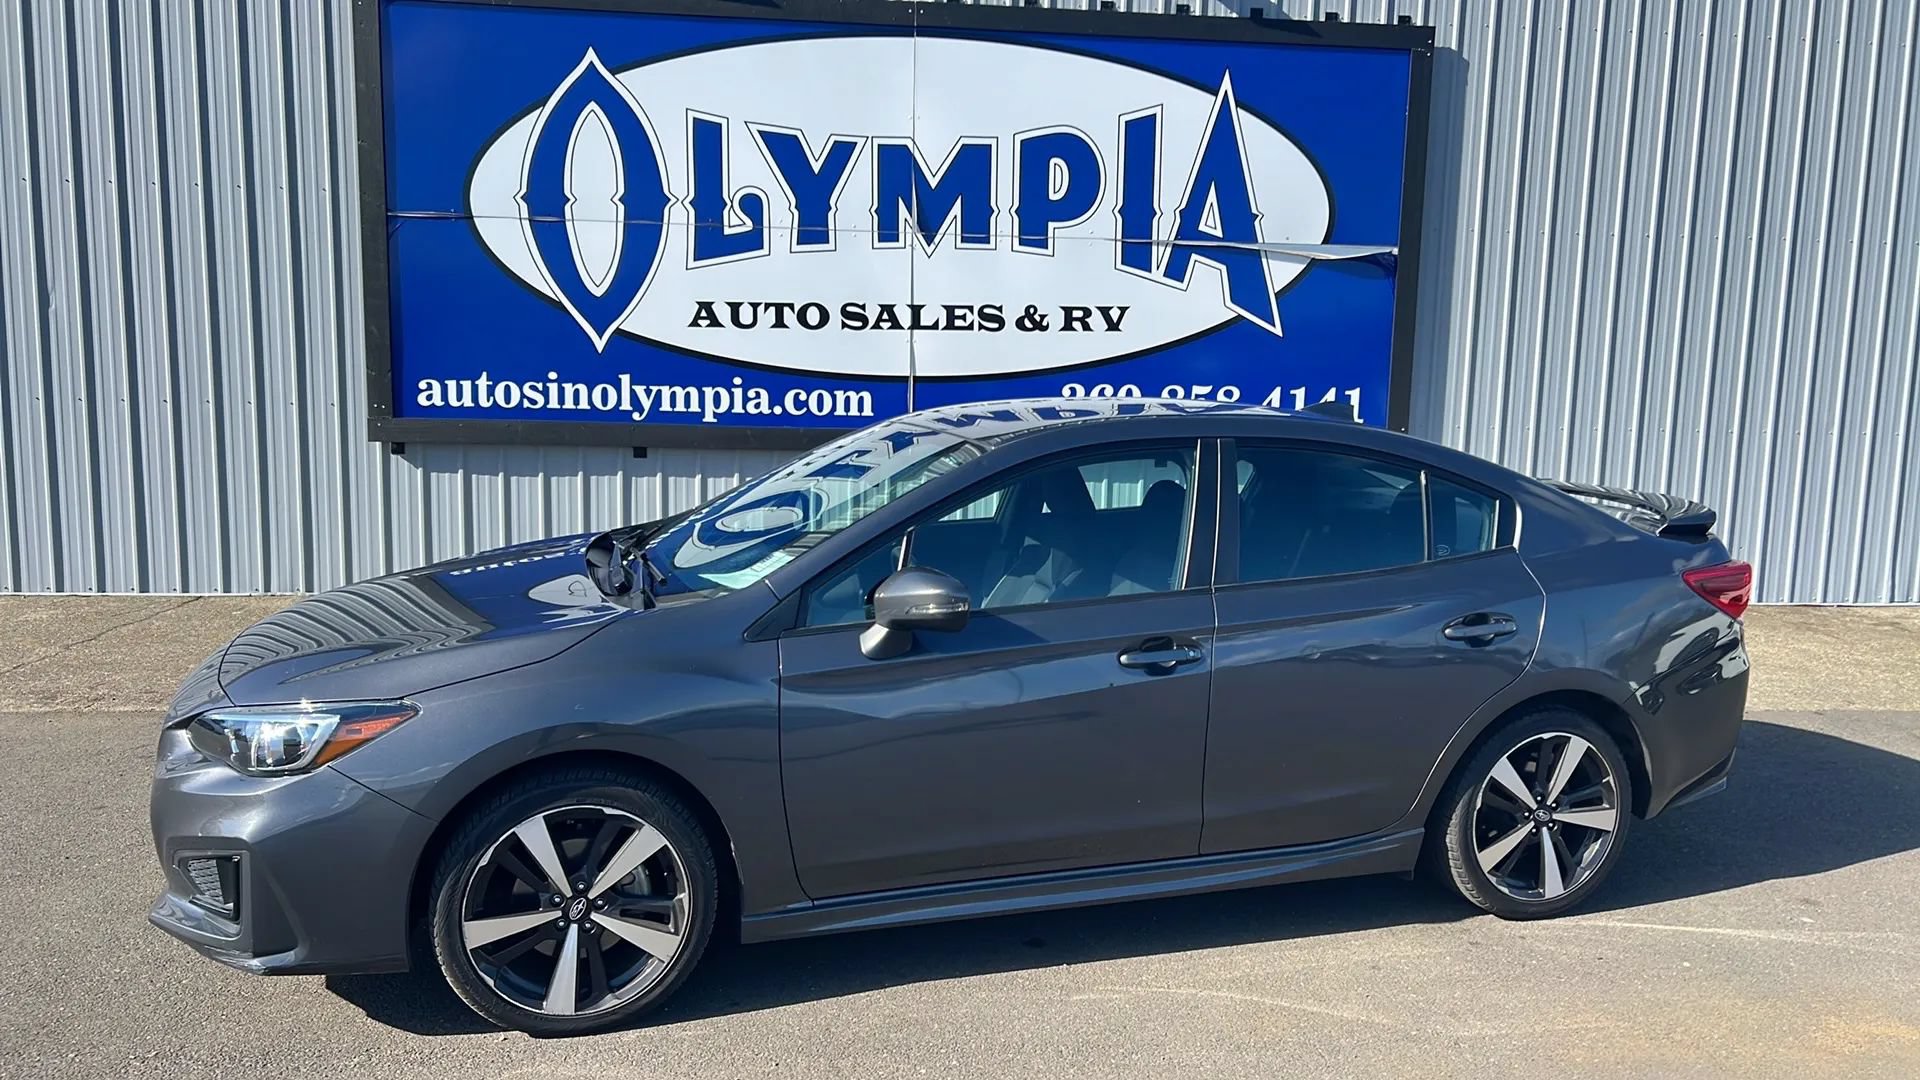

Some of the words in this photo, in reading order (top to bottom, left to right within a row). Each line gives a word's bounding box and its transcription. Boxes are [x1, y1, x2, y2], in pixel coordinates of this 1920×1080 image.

[514, 46, 1283, 353] OLYMPIA
[687, 300, 831, 331] AUTO
[839, 302, 1006, 332] SALES
[1014, 304, 1050, 332] &
[1057, 305, 1131, 332] RV
[416, 371, 875, 423] autosinolympia.com
